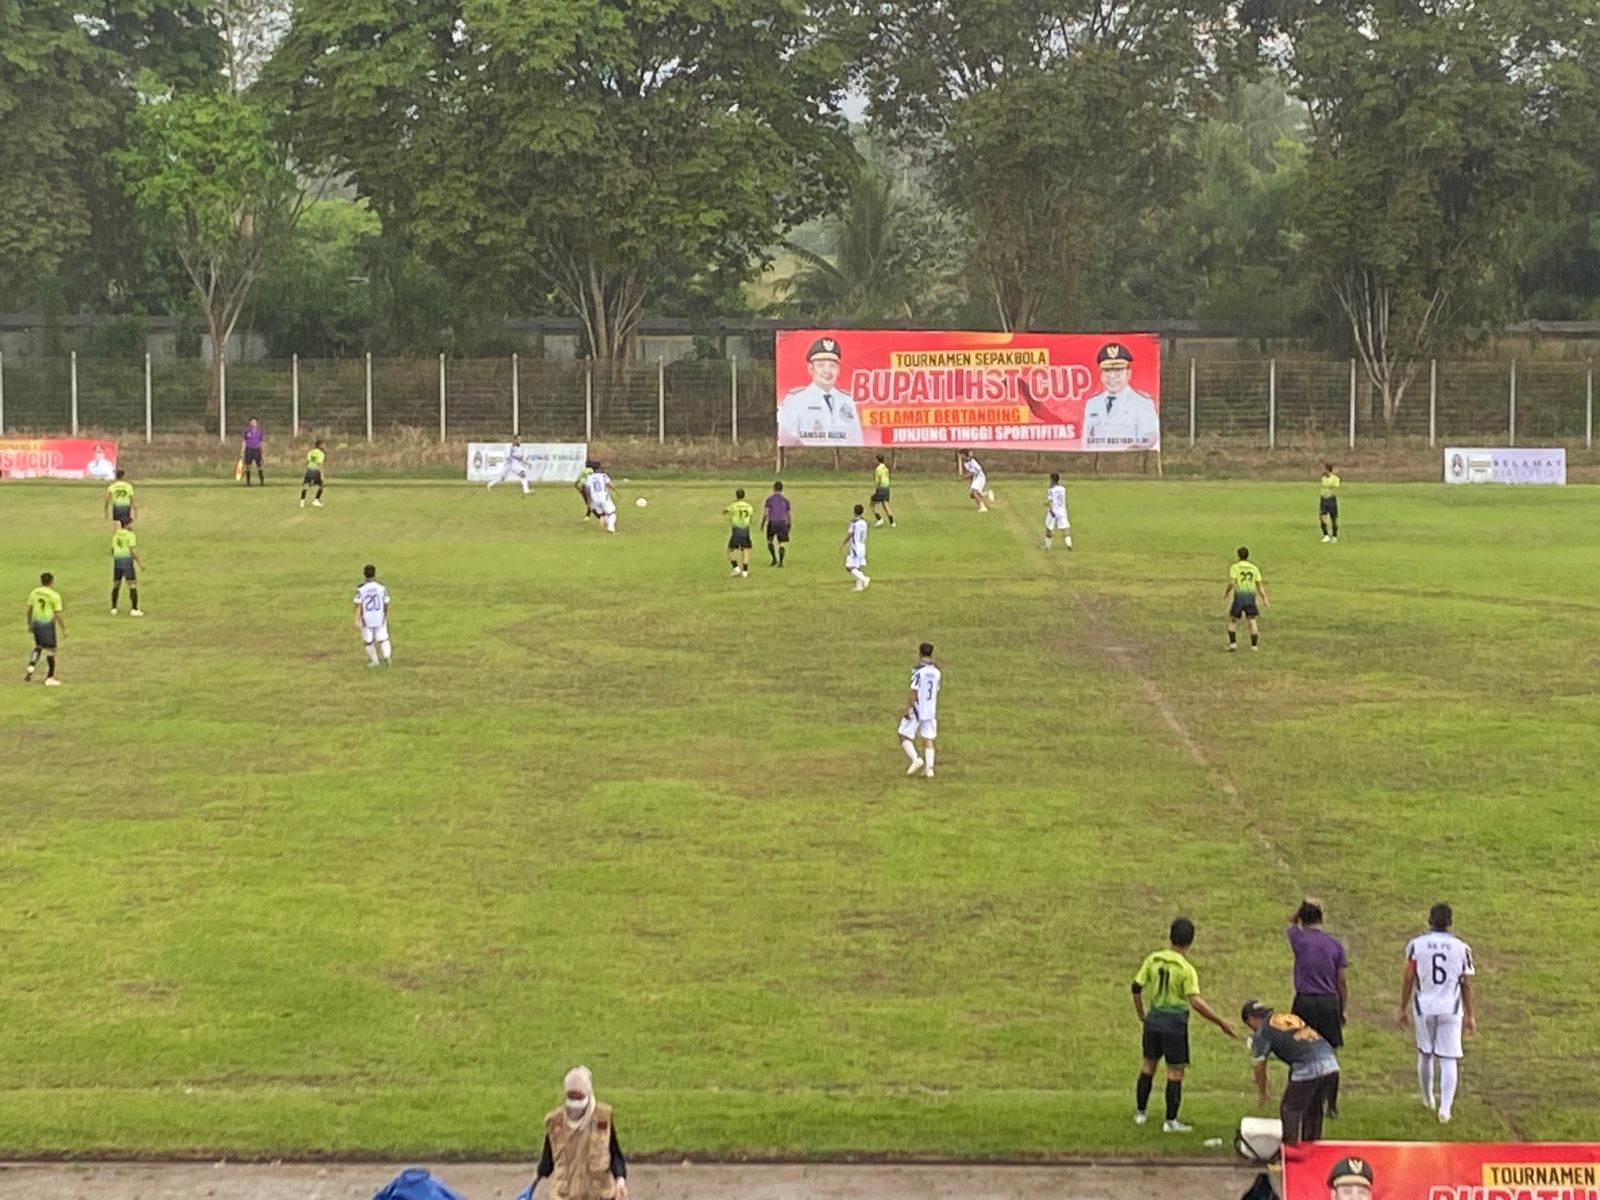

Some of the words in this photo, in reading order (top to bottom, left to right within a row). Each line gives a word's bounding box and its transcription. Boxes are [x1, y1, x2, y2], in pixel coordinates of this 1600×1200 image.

[895, 353, 970, 367] TOURNAMEN
[975, 351, 1047, 366] SEPAKBOLA
[852, 369, 955, 403] BUPATI
[964, 368, 1018, 401] HST
[1030, 367, 1092, 401] CUP
[869, 408, 930, 425] SELAMAT
[937, 407, 1021, 423] BERTANDING
[891, 427, 948, 443] JUNJUNG
[950, 426, 993, 442] TINGGI
[994, 424, 1075, 441] SPORTIFITAS
[28, 452, 62, 469] CUP
[363, 593, 381, 612] 20
[926, 680, 933, 701] 3
[1432, 952, 1448, 985] 6
[1158, 967, 1170, 993] 11
[1491, 1166, 1596, 1186] TOURNAMEN
